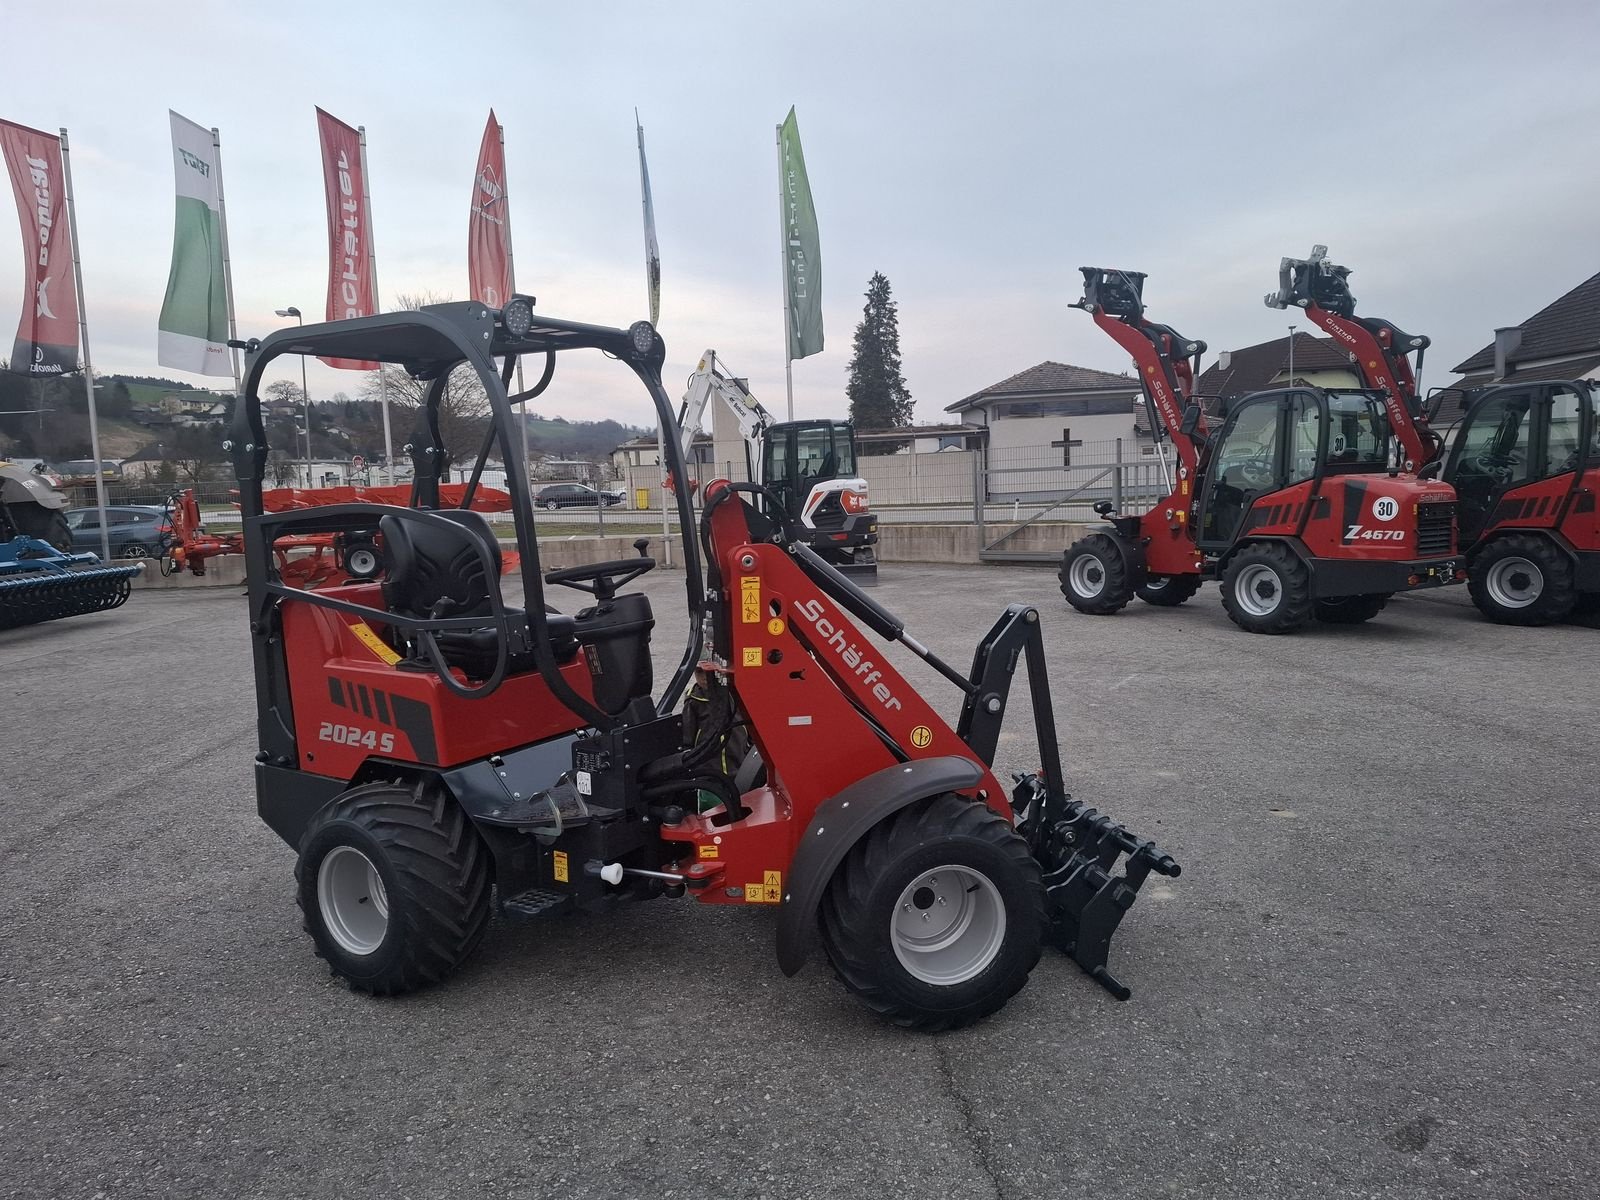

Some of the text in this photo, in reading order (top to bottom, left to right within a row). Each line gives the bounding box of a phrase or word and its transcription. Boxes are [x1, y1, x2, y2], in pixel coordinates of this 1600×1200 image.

[1375, 375, 1405, 426] Scäffer
[1334, 437, 1344, 452] 30
[1378, 501, 1393, 516] 30
[1344, 525, 1405, 541] Z4670
[794, 599, 902, 711] Schäffer
[319, 721, 395, 753] 2024 S
